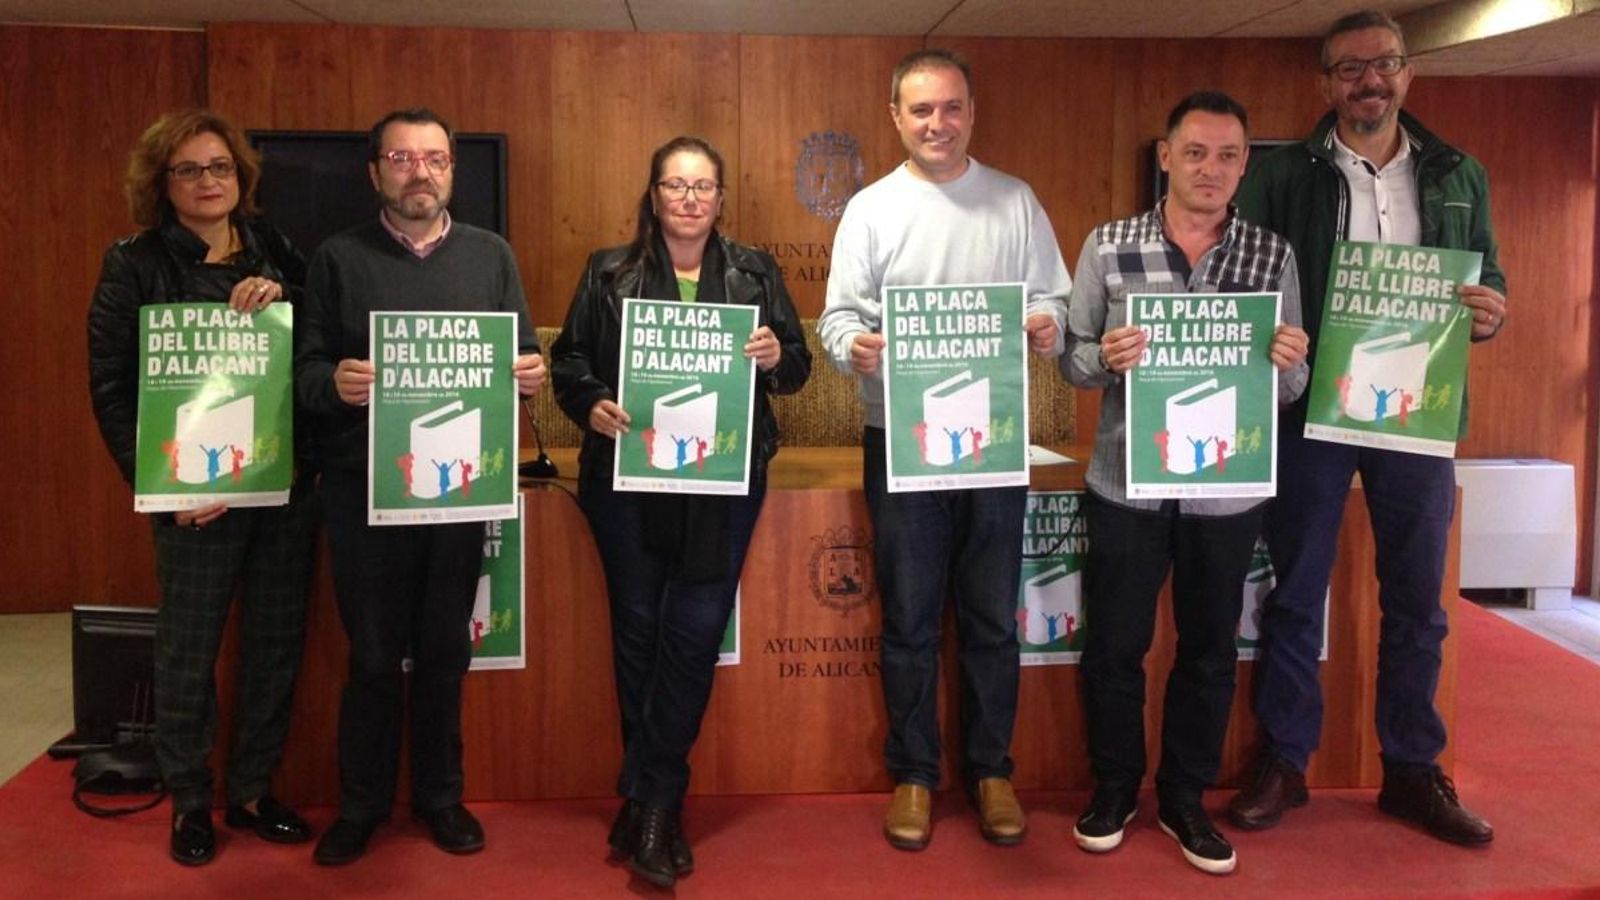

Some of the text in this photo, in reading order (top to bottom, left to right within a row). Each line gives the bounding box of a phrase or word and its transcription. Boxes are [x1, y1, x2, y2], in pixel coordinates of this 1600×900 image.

[753, 242, 832, 258] YUNTA
[1338, 246, 1440, 274] LA PLAÇA
[1334, 269, 1455, 300] DEL LLIBRE
[894, 290, 988, 313] LA PLAÇA
[1140, 299, 1238, 321] LA PLAÇA
[1331, 290, 1451, 323] D'ALACANT
[148, 308, 254, 331] LA PLAÇA
[634, 305, 721, 330] LA PLAÇA
[895, 314, 1002, 337] DEL LLIBRE
[383, 318, 480, 341] LA PLAÇA
[633, 328, 733, 351] DEL LLIBRE
[1140, 321, 1252, 343] DEL LLIBRE
[148, 332, 270, 353] DEL LLIBRE
[383, 341, 494, 363] DEL LLIBRE
[896, 337, 1002, 360] D'ALACANT
[632, 348, 733, 374] D'ALACANT
[383, 365, 494, 388] D'ALACANT
[779, 661, 807, 678] DE
